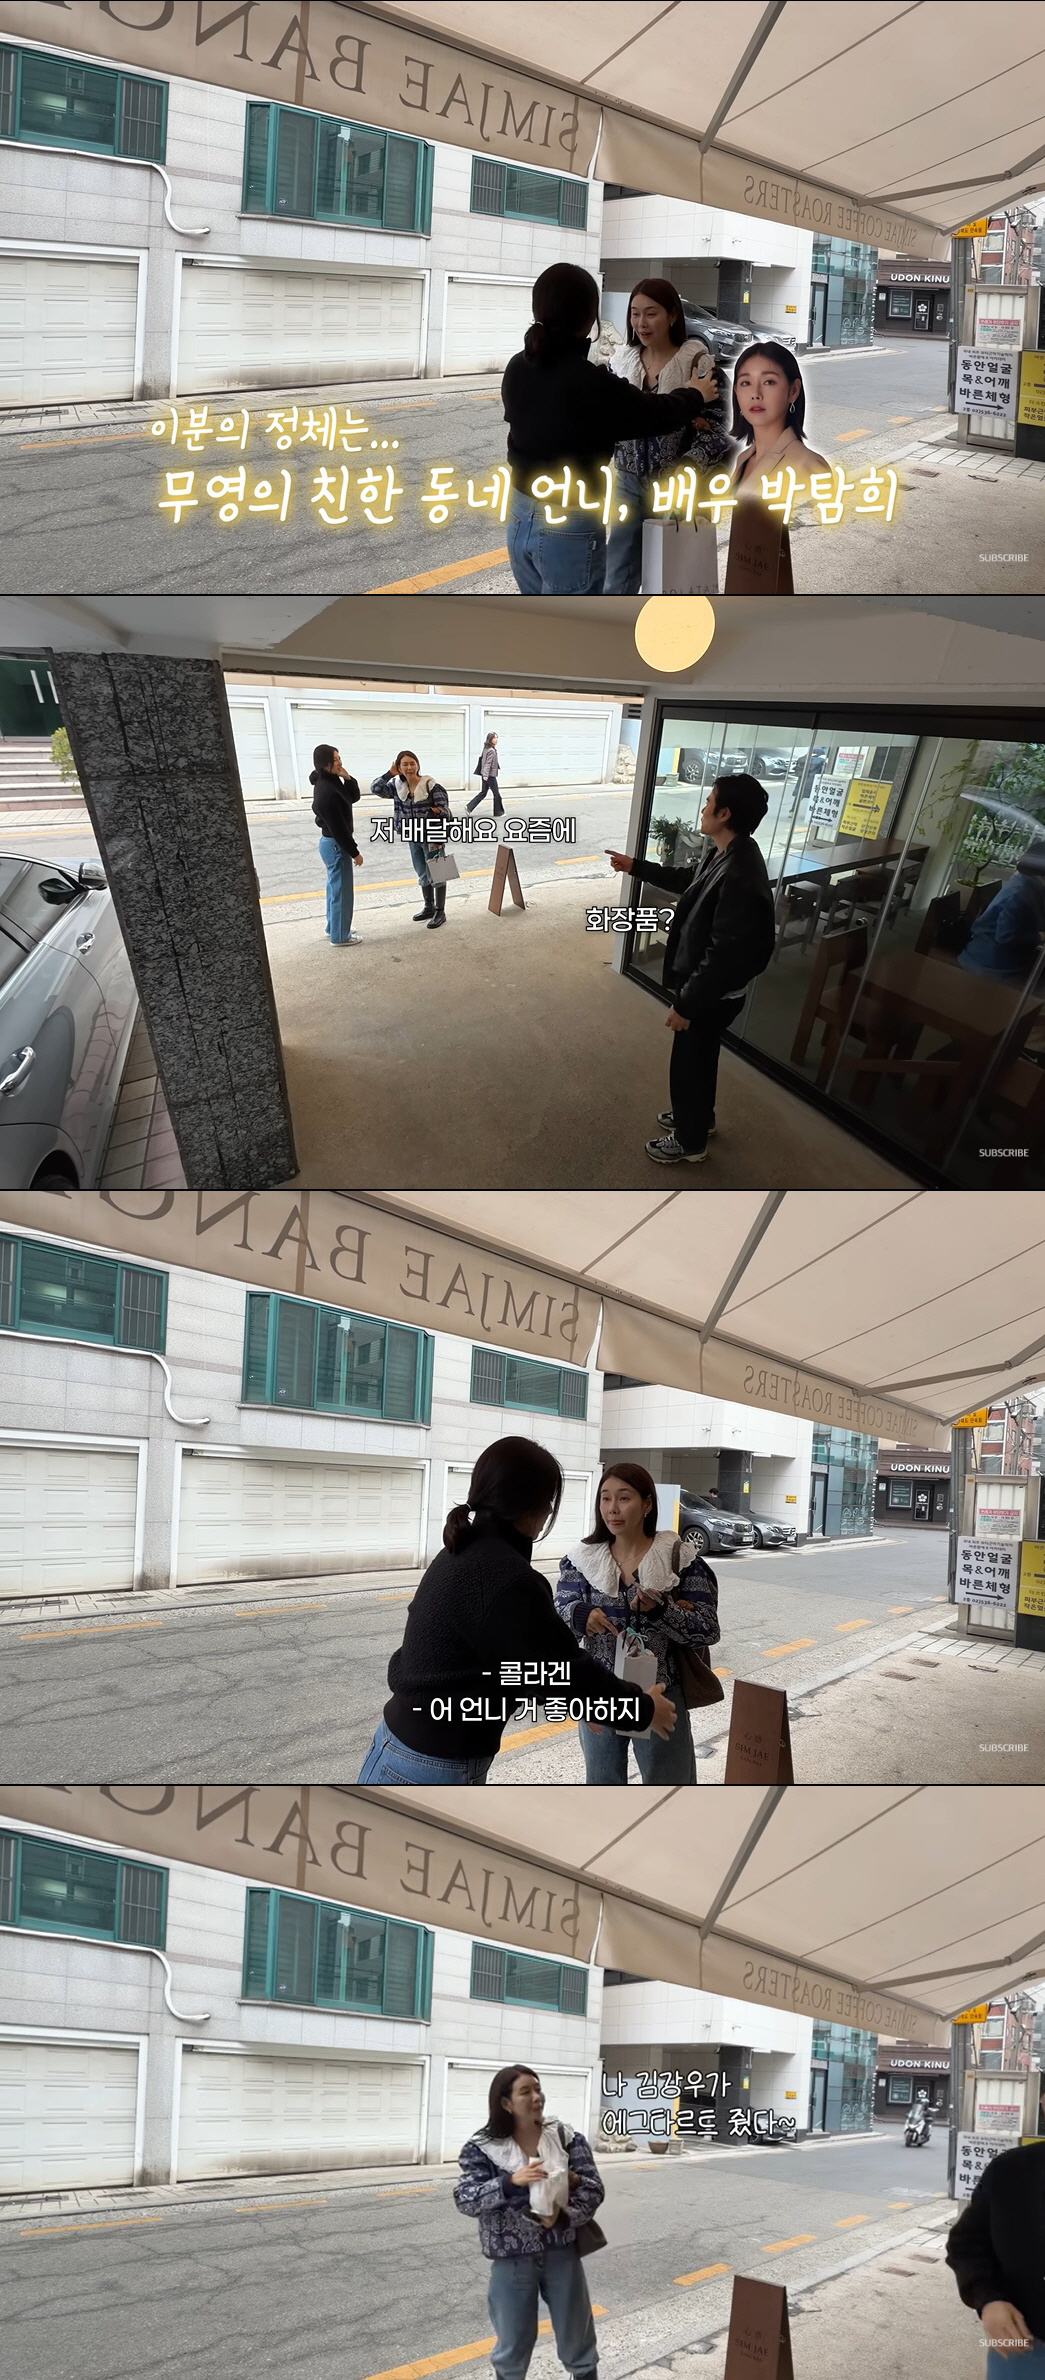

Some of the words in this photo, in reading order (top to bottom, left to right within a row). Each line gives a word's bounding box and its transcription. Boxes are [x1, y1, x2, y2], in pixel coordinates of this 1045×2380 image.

[890, 273, 921, 282] UDON
[924, 274, 950, 283] KINU
[961, 359, 1013, 375] 동안얼굴
[962, 374, 1010, 390] 목&어깨
[959, 388, 1011, 404] 바른체형
[1024, 406, 1045, 414] 피부근
[890, 1463, 921, 1472] UDON
[924, 1464, 950, 1473] KINU
[961, 1549, 1013, 1565] 동안얼굴
[962, 1564, 1010, 1580] 목&어깨
[959, 1578, 1011, 1594] 바른체형
[1024, 1596, 1045, 1604] 피부근
[735, 1743, 751, 1754] SIM
[753, 1749, 770, 1761] JAE
[890, 2059, 921, 2068] UDON
[924, 2060, 950, 2069] KINU
[961, 2145, 1007, 2159] 동안얼
